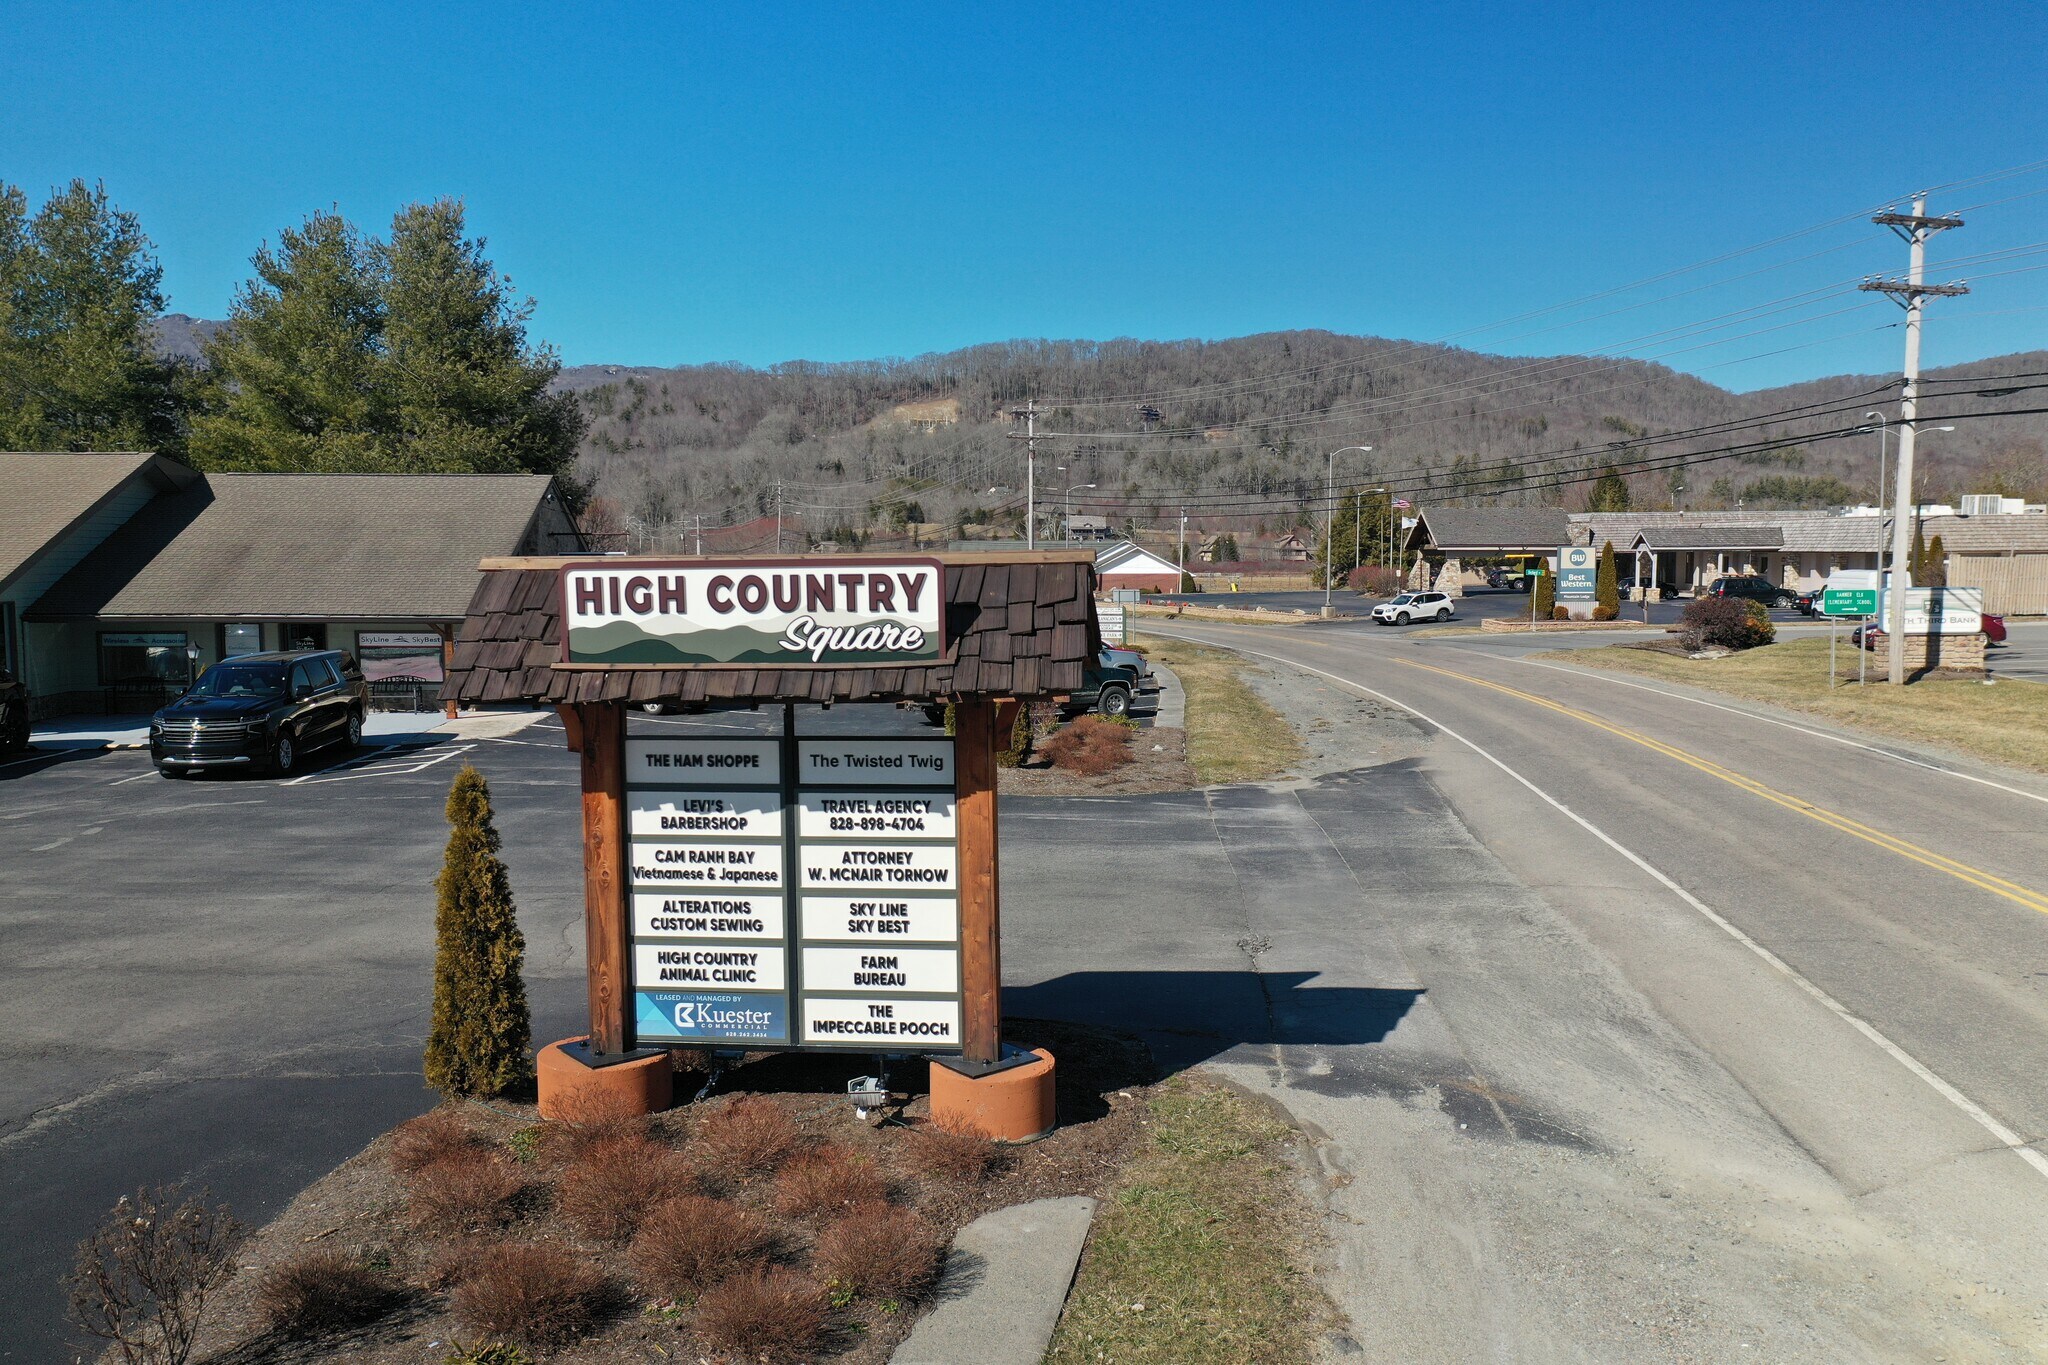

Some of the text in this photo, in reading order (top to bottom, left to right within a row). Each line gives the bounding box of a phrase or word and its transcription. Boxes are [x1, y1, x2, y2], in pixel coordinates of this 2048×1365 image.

[1571, 554, 1585, 562] BW
[1568, 573, 1585, 581] Best
[574, 573, 928, 615] HIGH COUNTRY
[361, 636, 440, 644] SkyLine SkyBest
[778, 615, 926, 663] Square
[646, 754, 759, 768] THE HAM SHOPPE
[810, 754, 944, 771] The Twisted Twig
[683, 800, 724, 813] LEVI'S
[821, 800, 931, 814] TRAVEL AGENCY
[661, 816, 748, 830] BARBERSHOP
[830, 817, 925, 831] 828-898-4704
[655, 850, 755, 864] CAM RANH BAY
[842, 852, 913, 865] ATTORNEY
[632, 866, 779, 883] Vietnamese & Japanese
[808, 867, 949, 882] W. MCNAIR TORNOW
[663, 900, 752, 914] ALTERATIONS
[849, 903, 908, 917] SKY LINE
[651, 917, 764, 932] CUSTOM SEWING
[848, 919, 910, 933] SKY BEST
[658, 952, 758, 966] HIGH COUNTRY
[861, 956, 899, 969] FARM
[659, 968, 757, 983] ANIMAL CLINIC
[854, 972, 907, 986] BUREAU
[696, 1003, 772, 1024] Kuester
[868, 1005, 893, 1018] THE
[813, 1020, 950, 1035] IMPECCABLE POOCH
